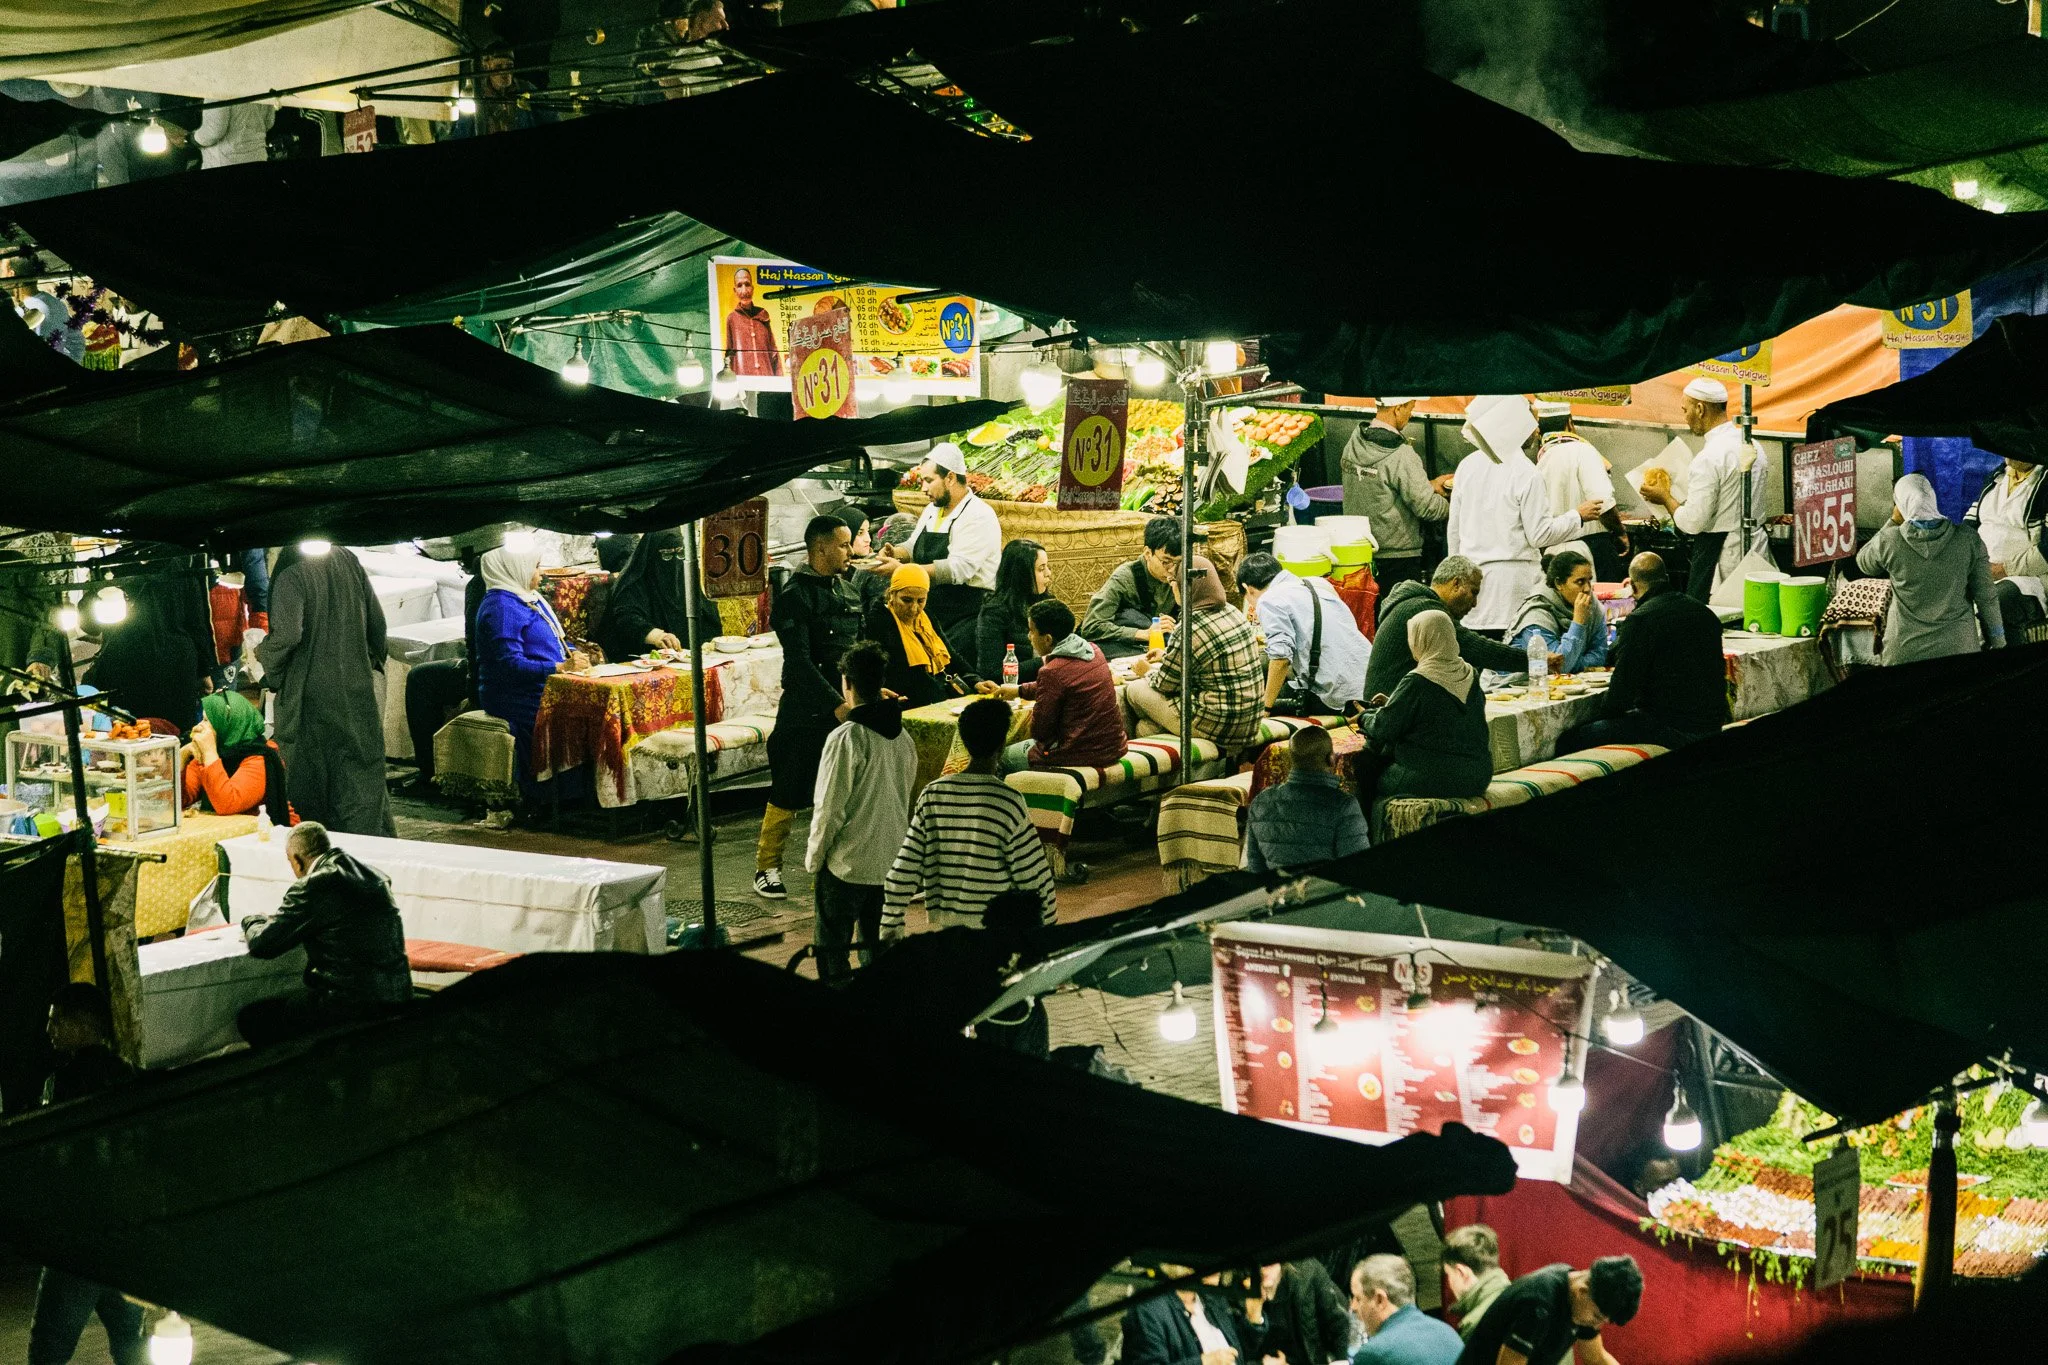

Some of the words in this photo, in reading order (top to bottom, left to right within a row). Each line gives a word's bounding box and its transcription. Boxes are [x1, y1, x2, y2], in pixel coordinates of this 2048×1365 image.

[760, 269, 781, 281] Haj
[783, 269, 824, 281] Hassan
[1886, 332, 1903, 344] Haj
[1904, 331, 1935, 342] Hassan
[1794, 449, 1821, 466] CHEZ
[706, 531, 763, 579] 30
